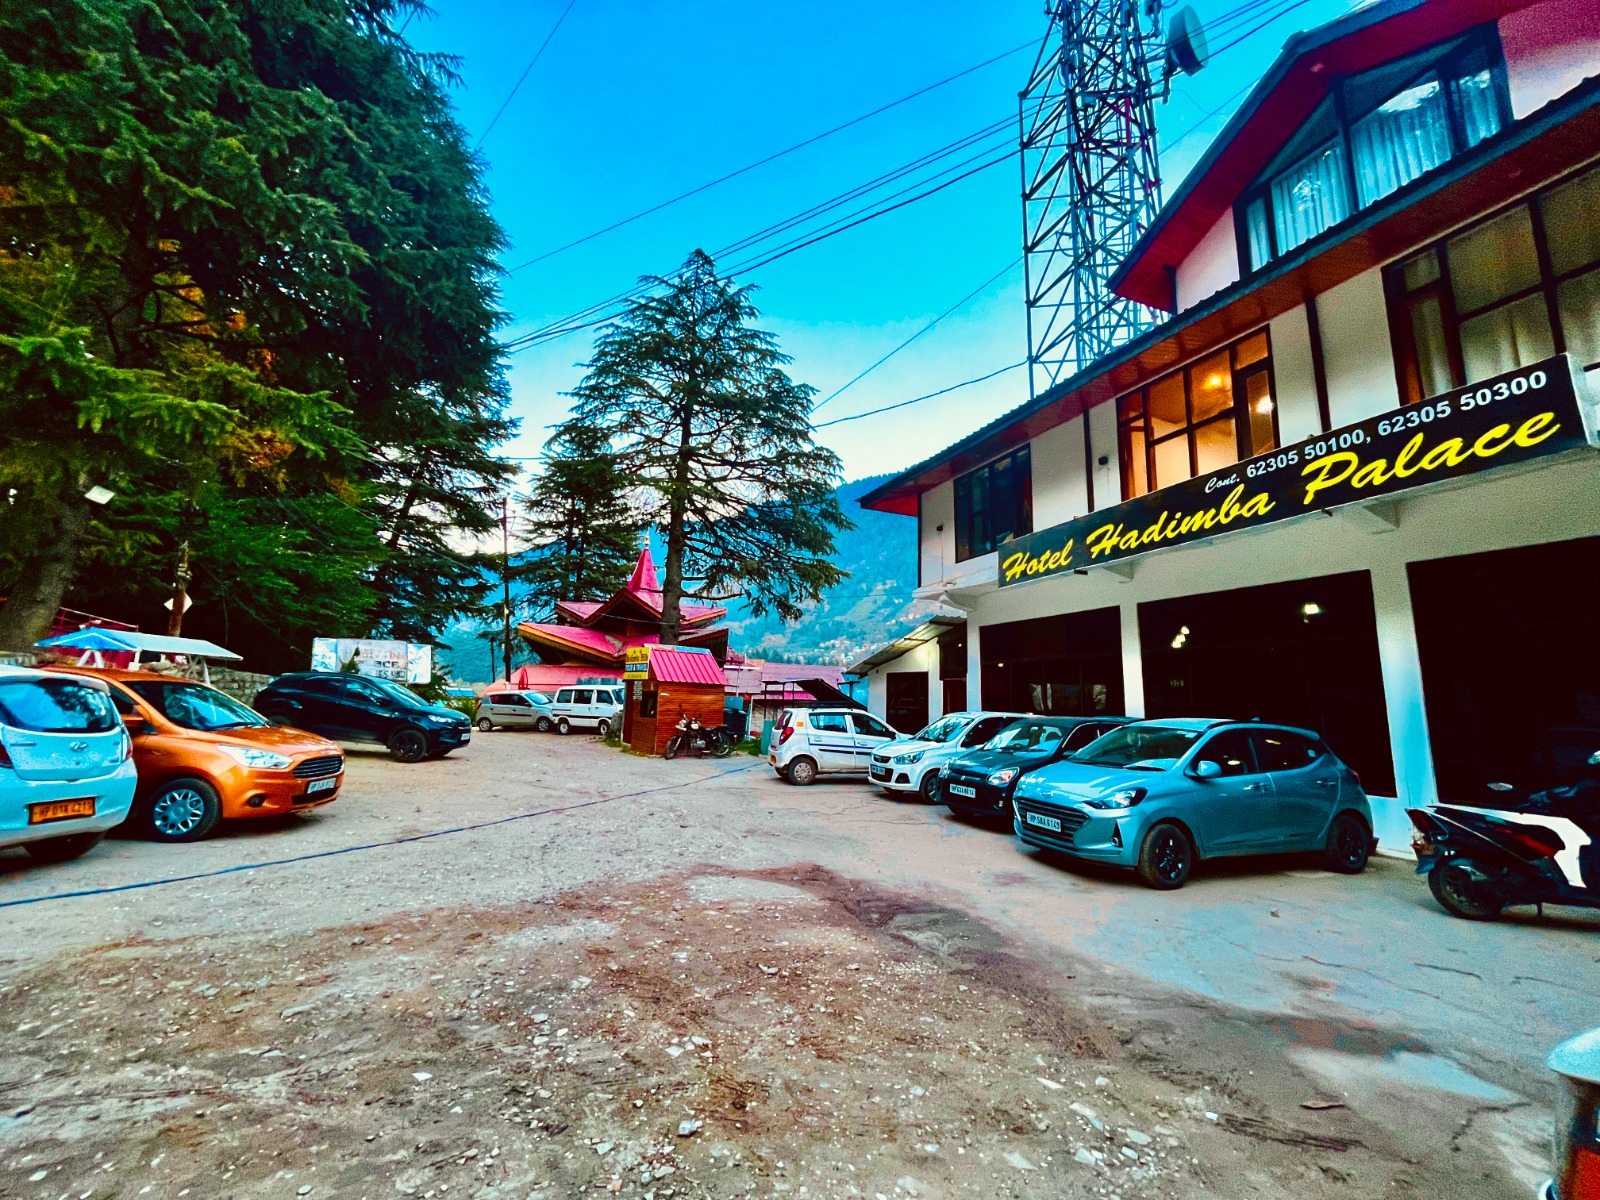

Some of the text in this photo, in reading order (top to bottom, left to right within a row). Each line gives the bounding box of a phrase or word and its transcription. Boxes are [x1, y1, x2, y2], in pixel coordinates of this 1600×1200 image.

[1002, 411, 1561, 582] Hotel Hadimba Palace
[1204, 370, 1547, 494] Cont. 62305 50100, 62305 50300
